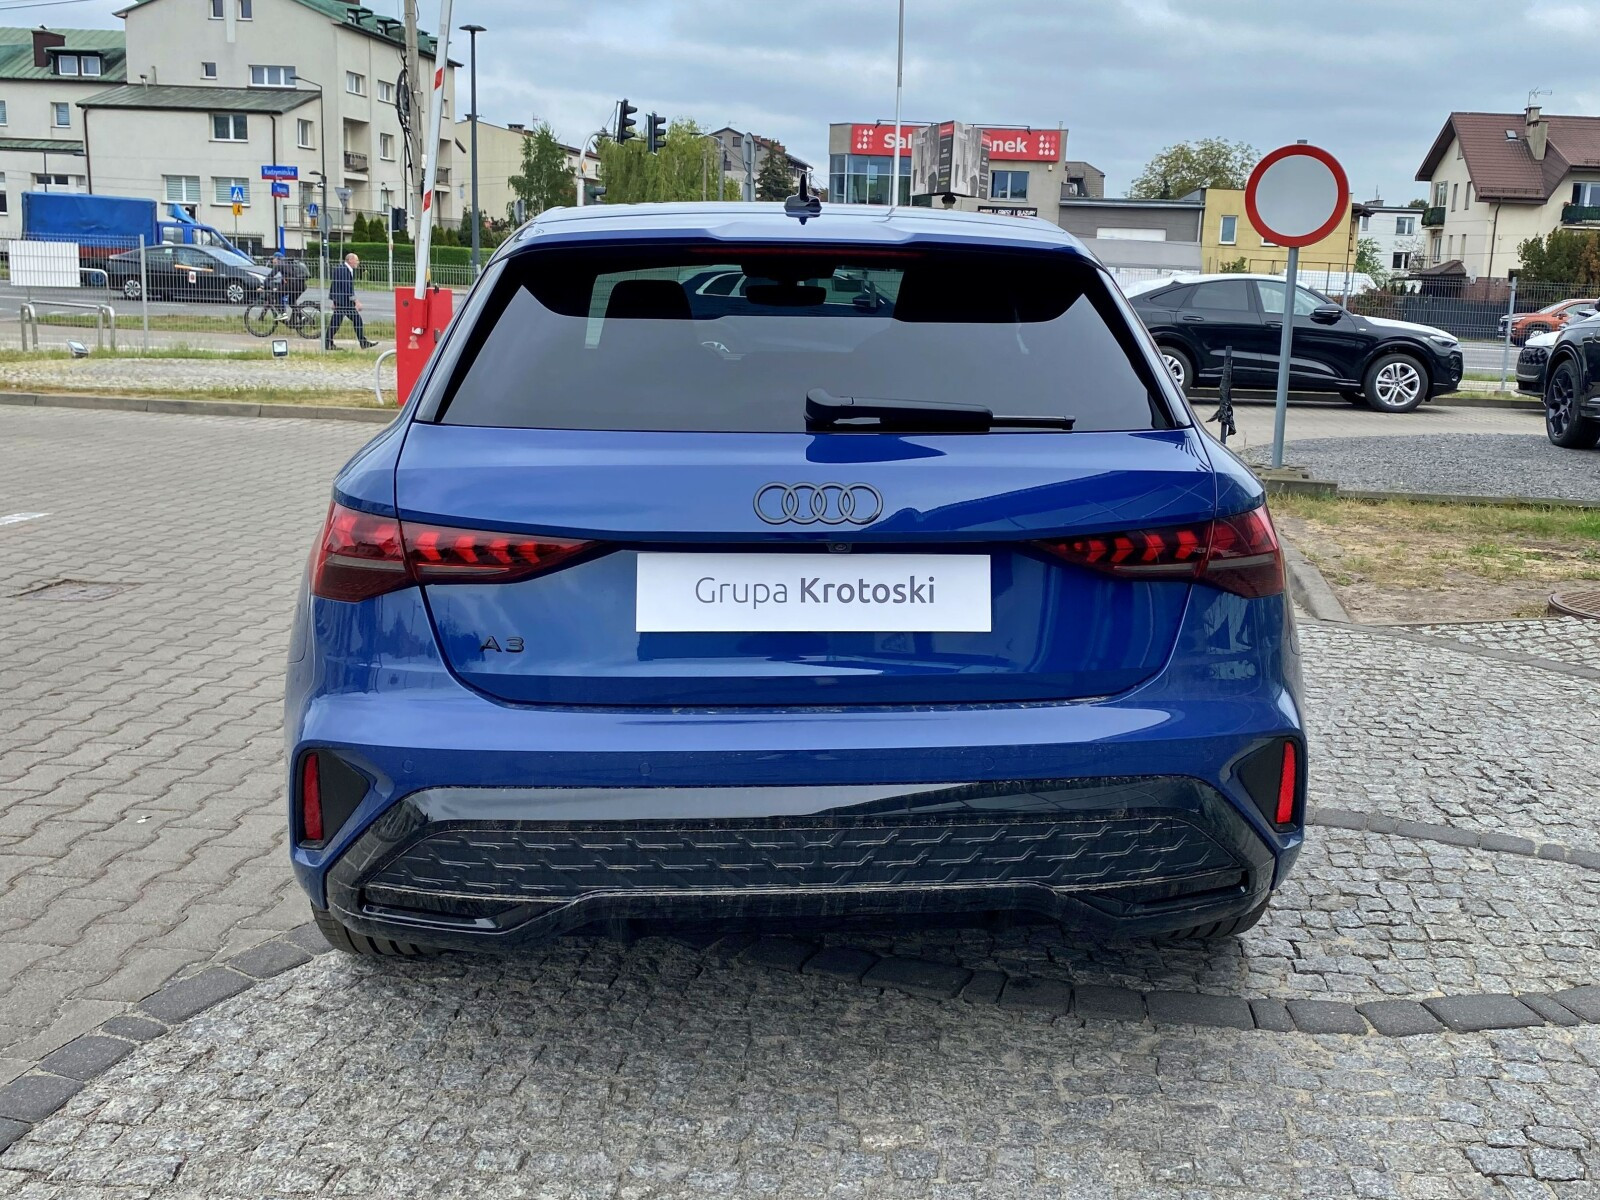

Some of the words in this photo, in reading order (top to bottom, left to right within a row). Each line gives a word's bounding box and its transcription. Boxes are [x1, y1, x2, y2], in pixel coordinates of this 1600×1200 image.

[884, 133, 912, 149] Sal
[695, 576, 788, 609] Grupa
[800, 575, 935, 604] Krotoski
[479, 635, 525, 653] A3
